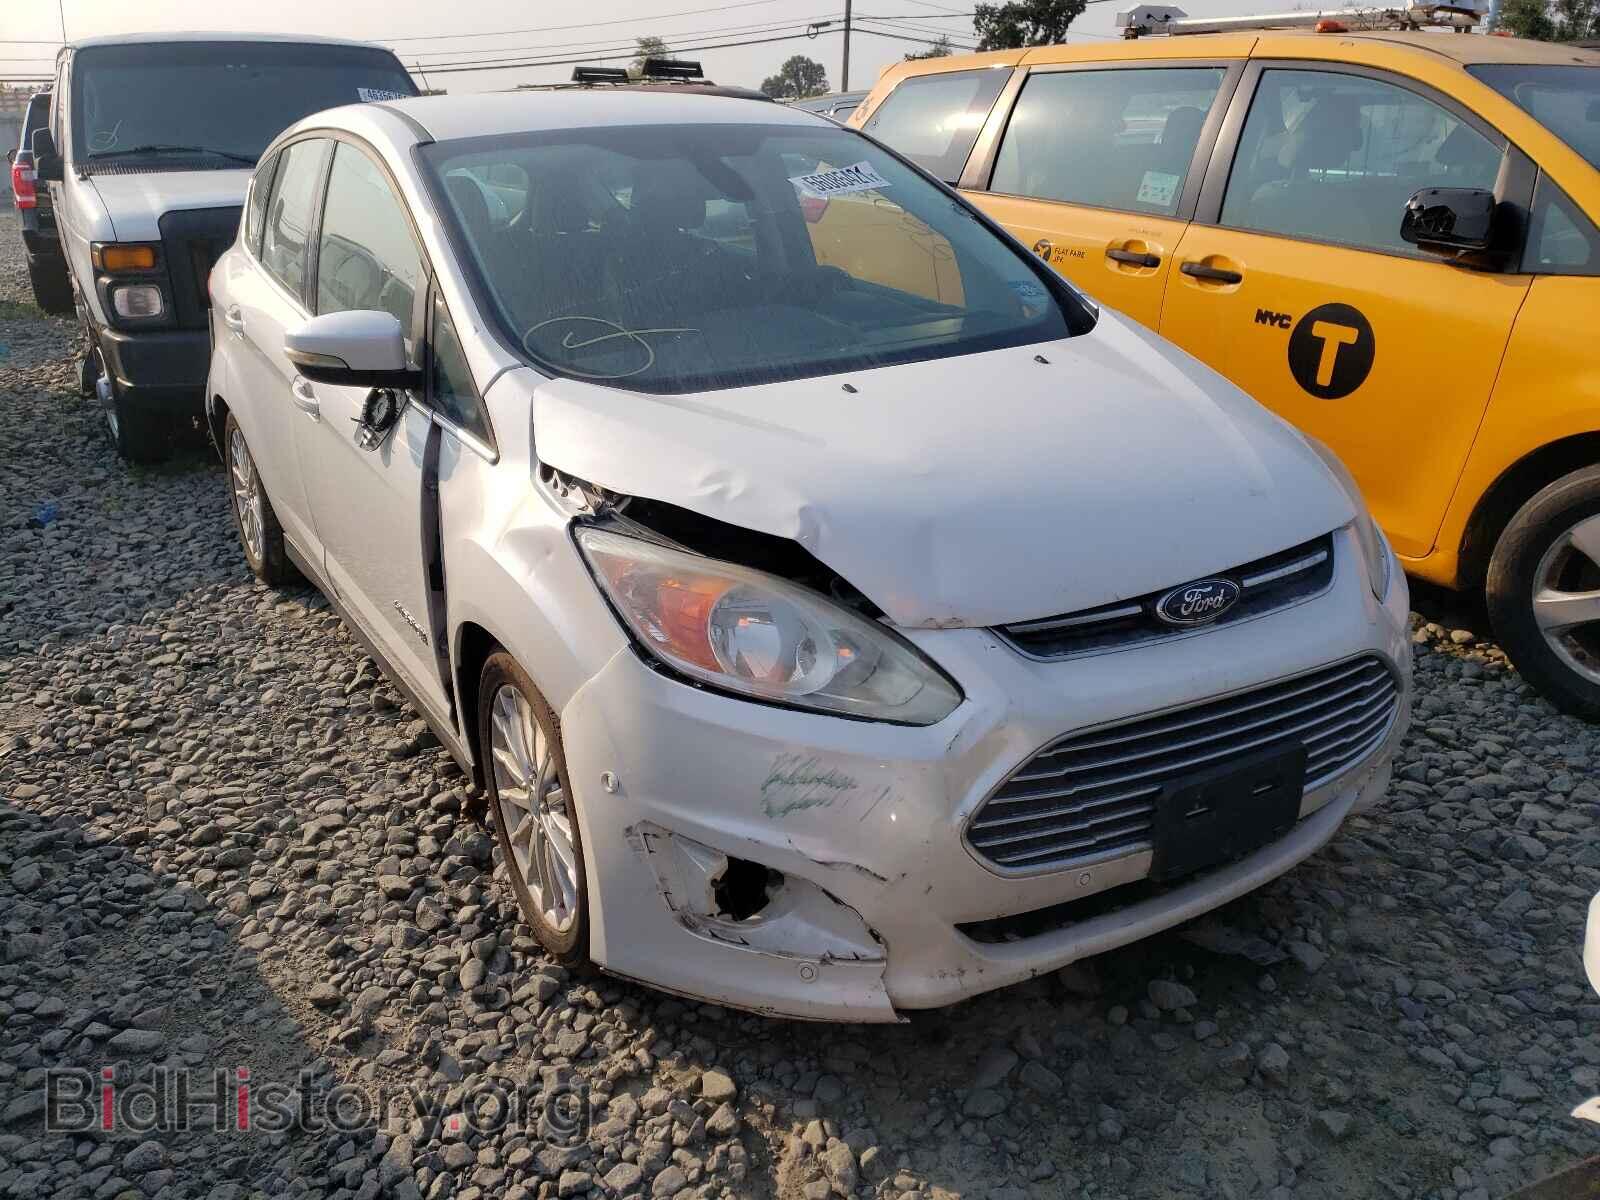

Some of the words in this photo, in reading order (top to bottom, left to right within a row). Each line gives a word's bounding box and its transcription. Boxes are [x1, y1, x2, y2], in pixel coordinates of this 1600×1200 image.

[1054, 247, 1069, 256] FLAT
[1069, 250, 1086, 258] FARE
[1254, 308, 1292, 329] NYC
[1311, 319, 1359, 387] T
[1180, 586, 1225, 616] Ford
